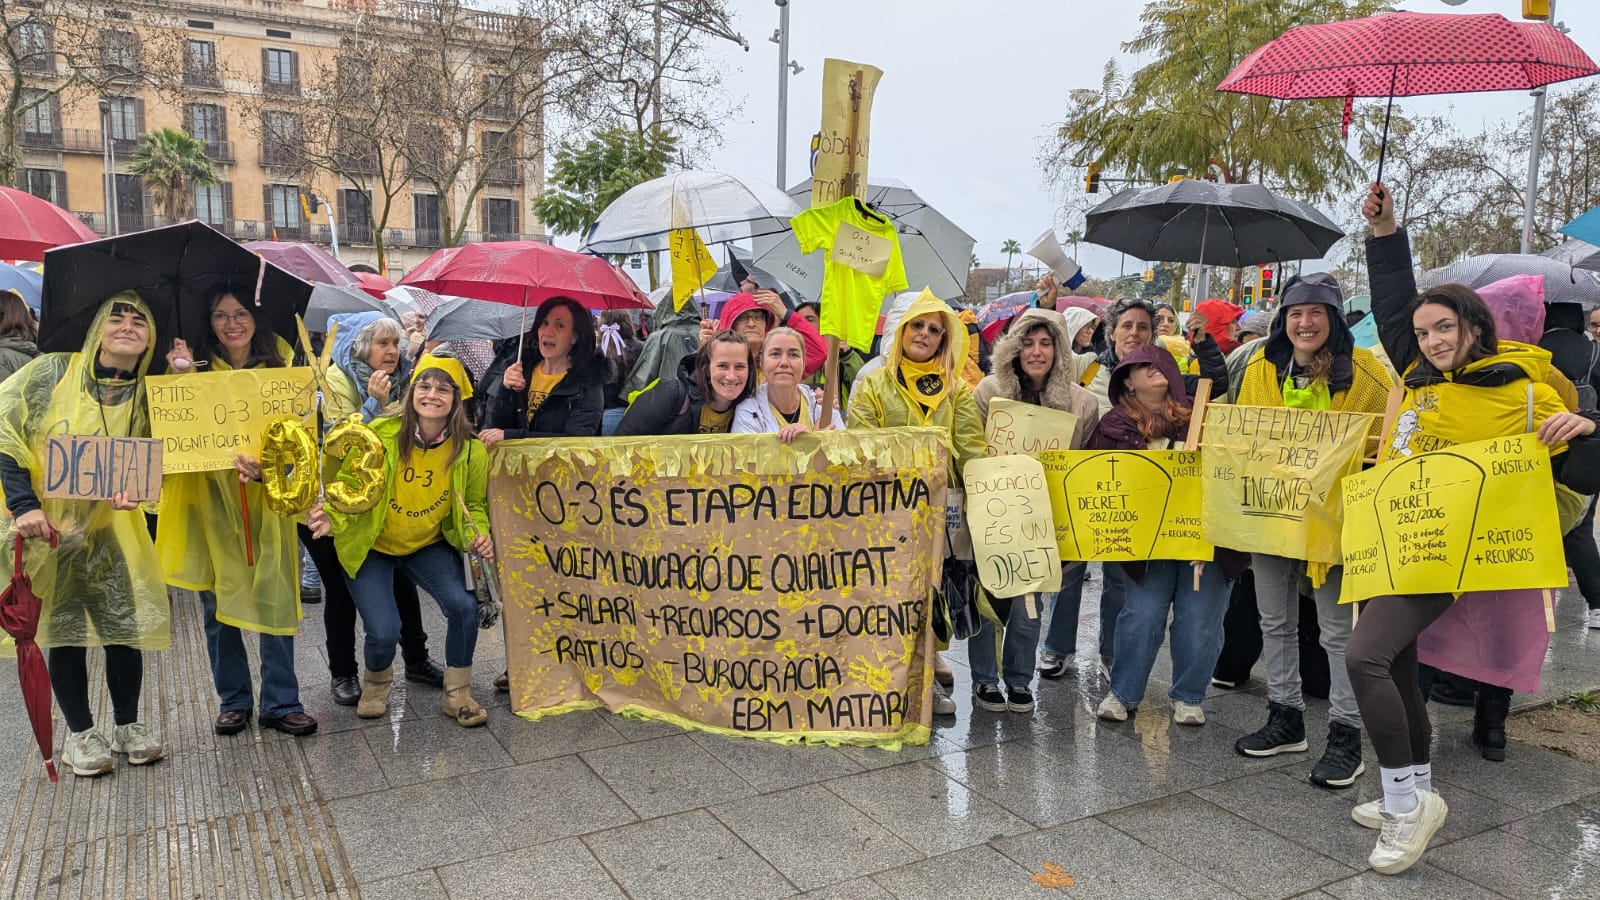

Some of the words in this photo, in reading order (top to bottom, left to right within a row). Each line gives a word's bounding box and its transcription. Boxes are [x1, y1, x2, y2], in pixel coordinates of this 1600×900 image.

[150, 384, 195, 403] PETITS
[260, 380, 301, 399] GRANS
[213, 400, 250, 425] 0-3
[167, 432, 250, 453] DIGNIFIQUEM
[990, 410, 1015, 449] PER
[1022, 436, 1060, 452] UNA
[47, 436, 160, 498] DIGNITAT
[1276, 446, 1318, 469] DRETS
[403, 466, 434, 488] 0-3
[965, 473, 1043, 496] EDUCACIÓ
[536, 480, 603, 526] 0-3
[610, 480, 648, 527] ÉS
[666, 483, 777, 526] ETAPA
[1078, 494, 1130, 510] DECRET
[1240, 475, 1313, 511] INFANTS
[1389, 491, 1432, 512] DECRET
[986, 495, 1033, 517] 0-3
[1089, 510, 1138, 524] 282/2006
[1397, 507, 1446, 525] 282/2006
[985, 521, 1013, 545] ÉS
[1021, 519, 1047, 541] UN
[621, 548, 720, 592] EDUCACIÓ
[727, 554, 763, 591] DE
[986, 547, 1054, 590] DRET
[733, 696, 792, 732] EBM
